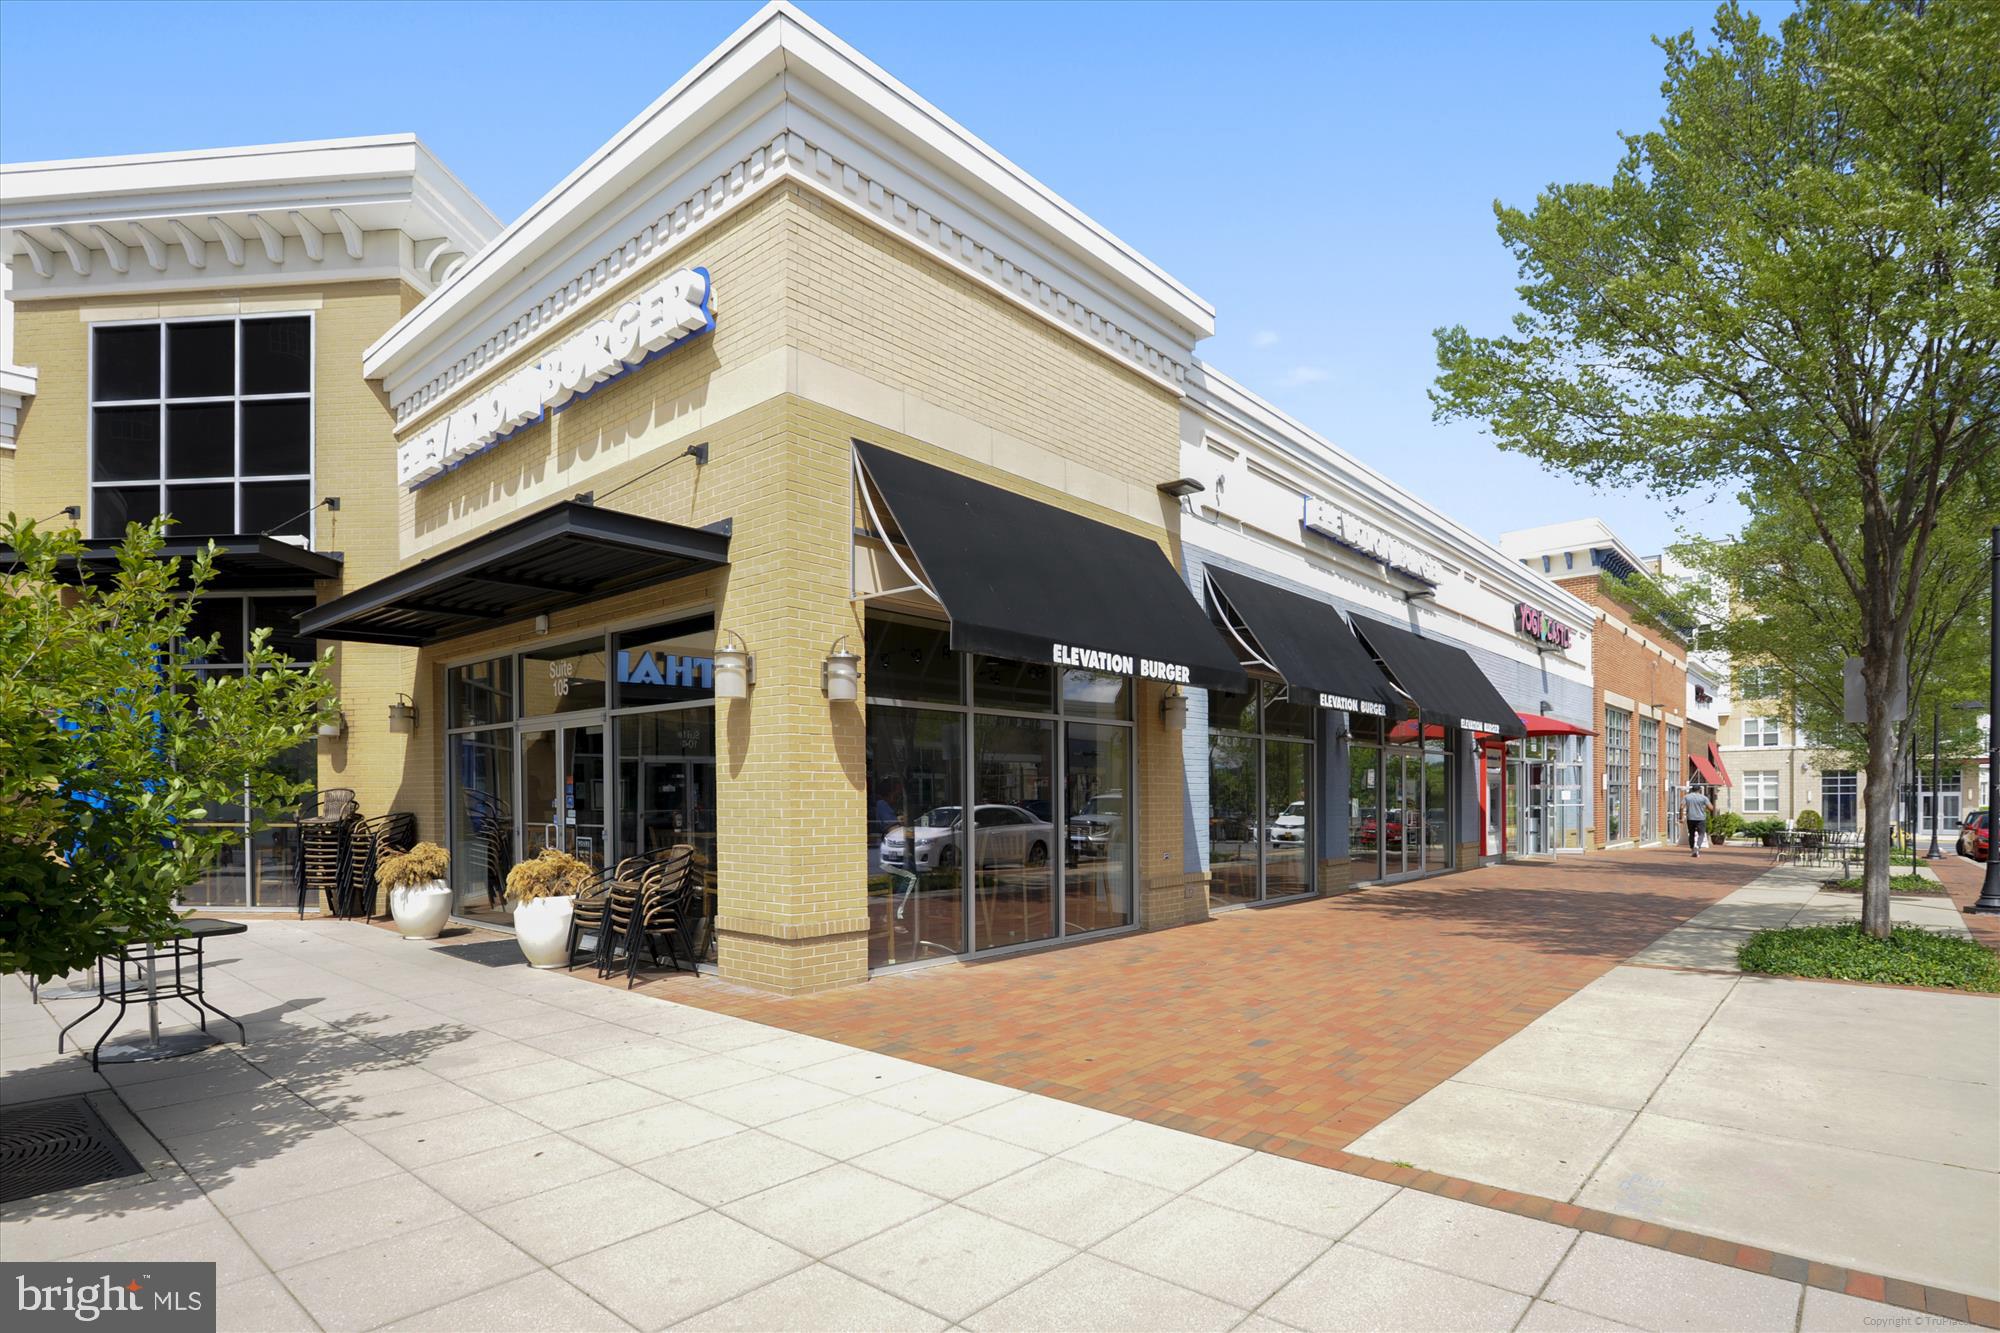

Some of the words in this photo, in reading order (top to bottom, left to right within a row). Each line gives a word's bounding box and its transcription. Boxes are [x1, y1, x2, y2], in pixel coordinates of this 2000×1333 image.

[549, 661, 573, 678] Suite
[1053, 643, 1134, 675] ELEVATION
[1140, 659, 1190, 683] BURGER
[552, 679, 569, 696] 105
[1320, 693, 1359, 712] ELEVATION
[1360, 701, 1387, 716] BURGER
